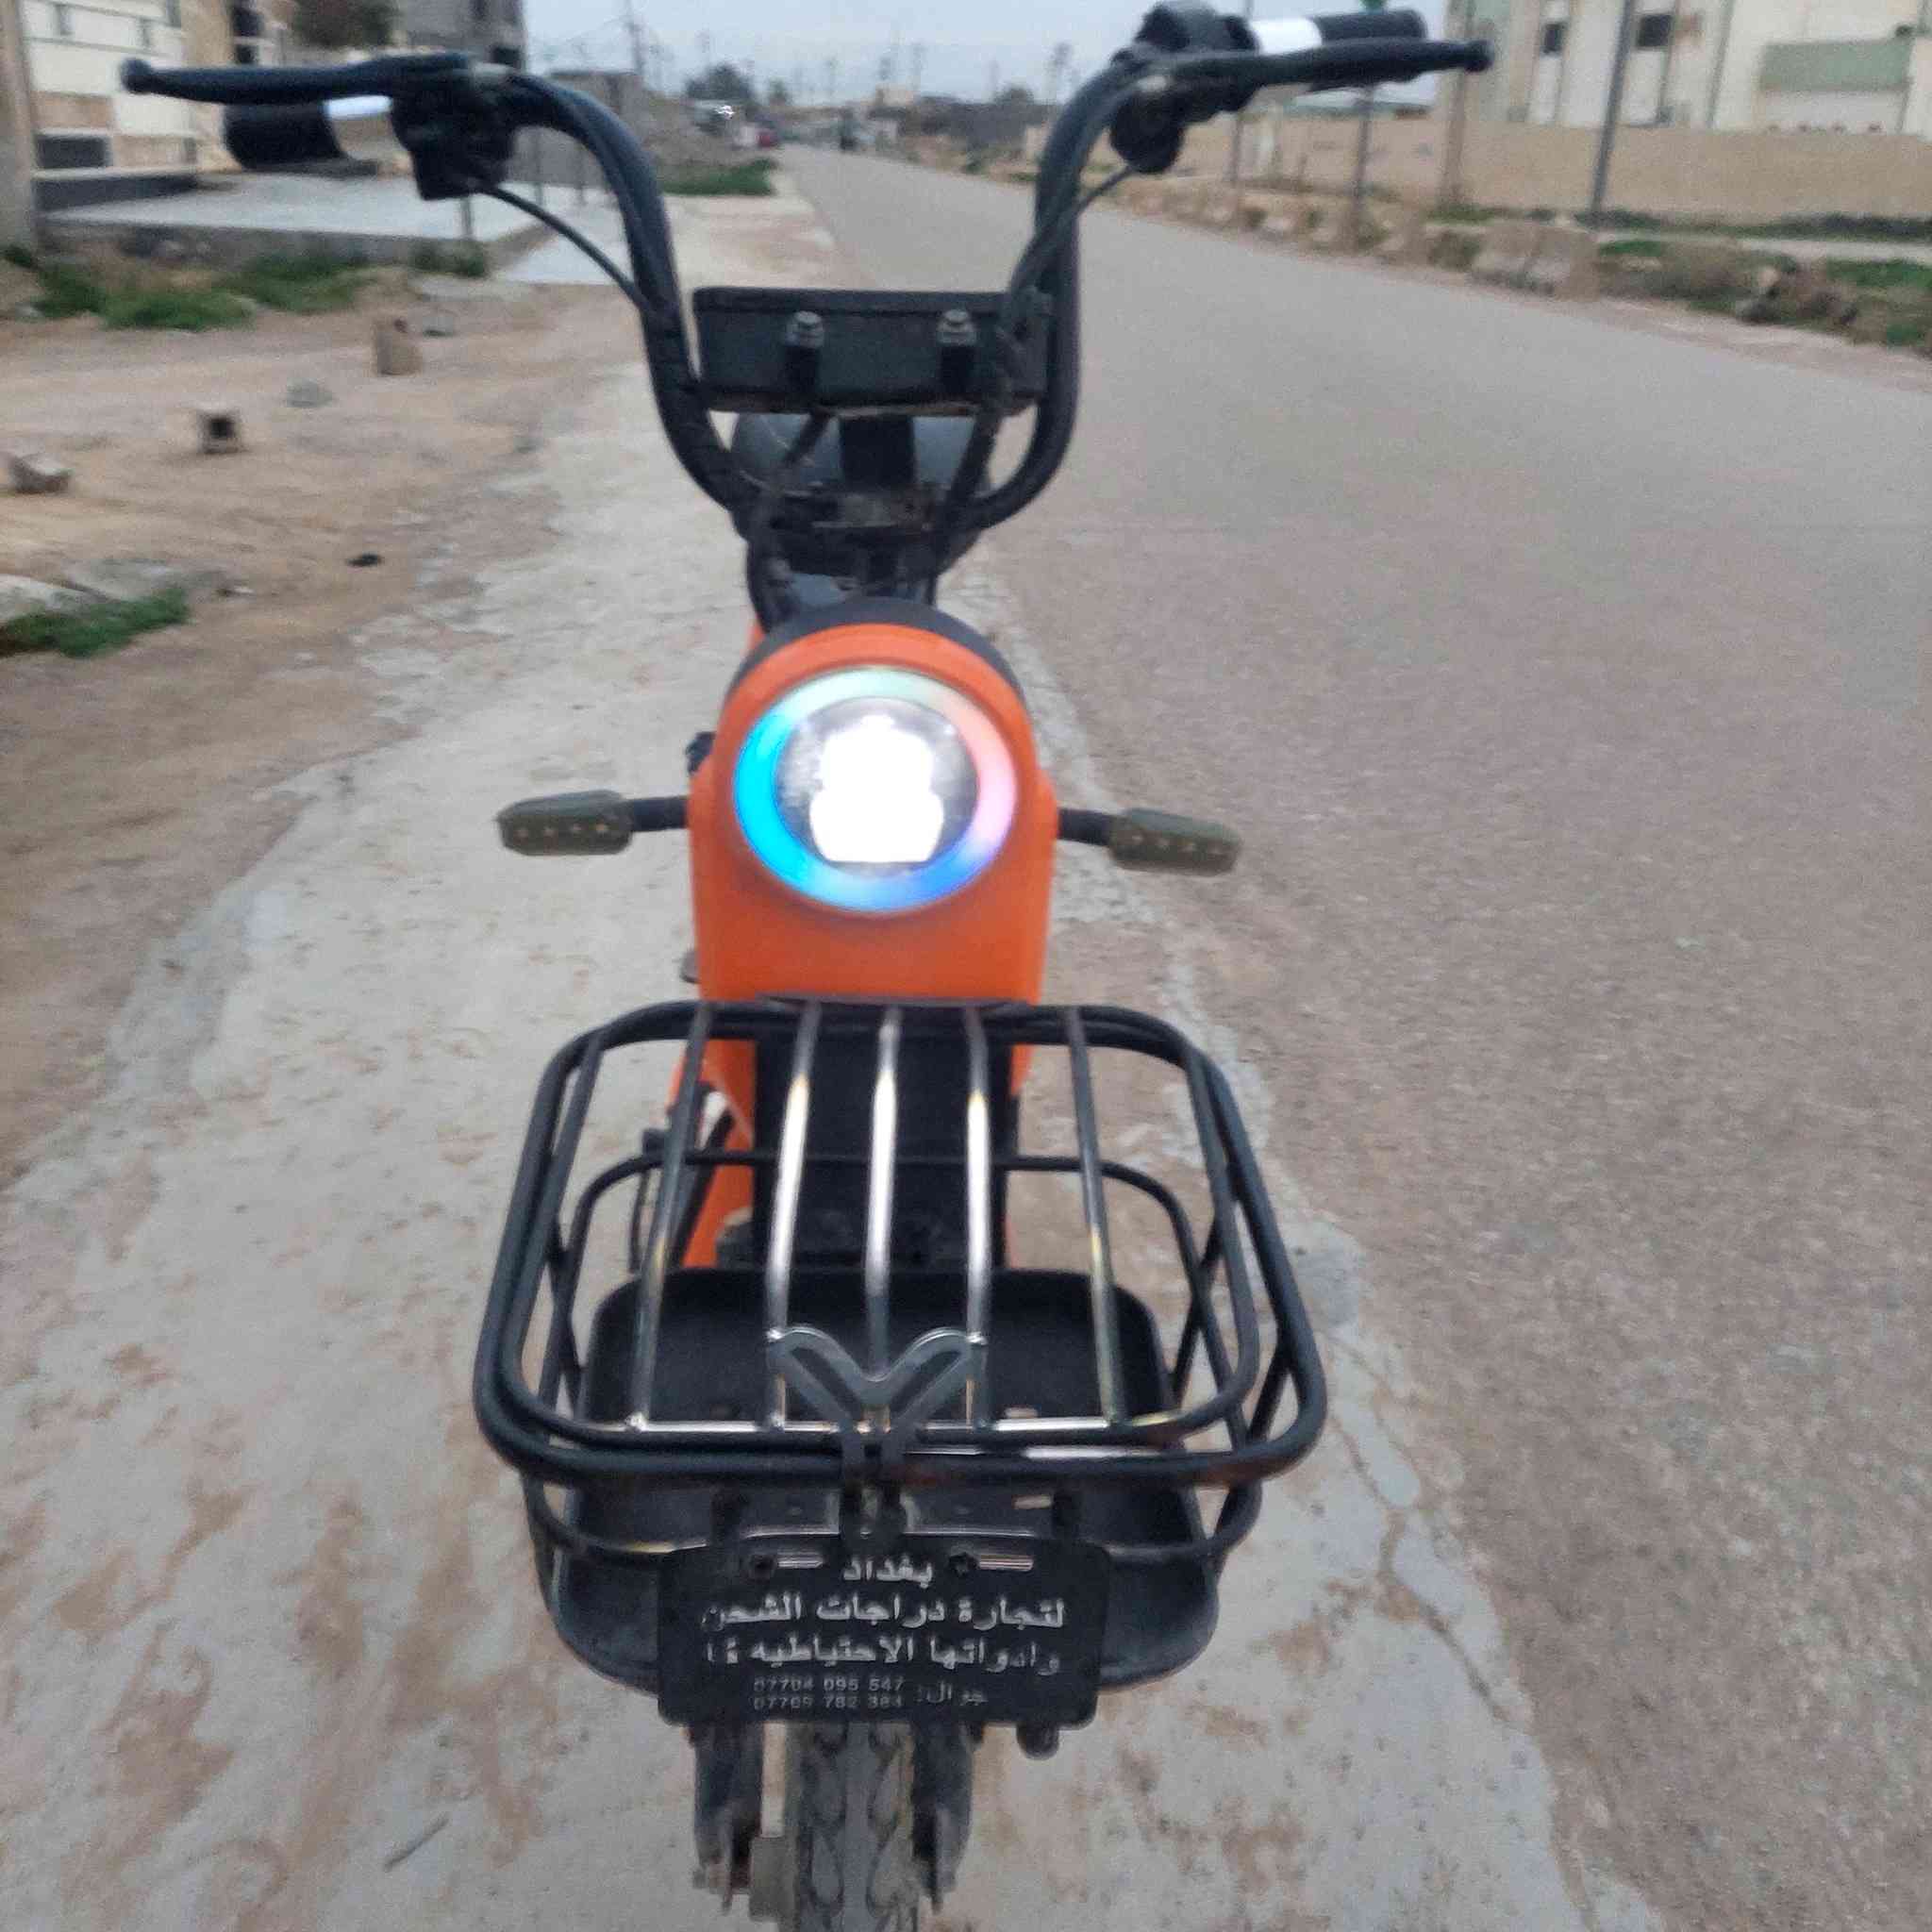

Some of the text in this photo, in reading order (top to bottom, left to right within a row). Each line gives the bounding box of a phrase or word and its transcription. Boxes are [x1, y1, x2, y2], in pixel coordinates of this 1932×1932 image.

[842, 1553, 934, 1589] بغداد
[816, 1593, 945, 1628] دراجات
[958, 1595, 1065, 1630] لتجارة
[869, 1675, 906, 1691] 547
